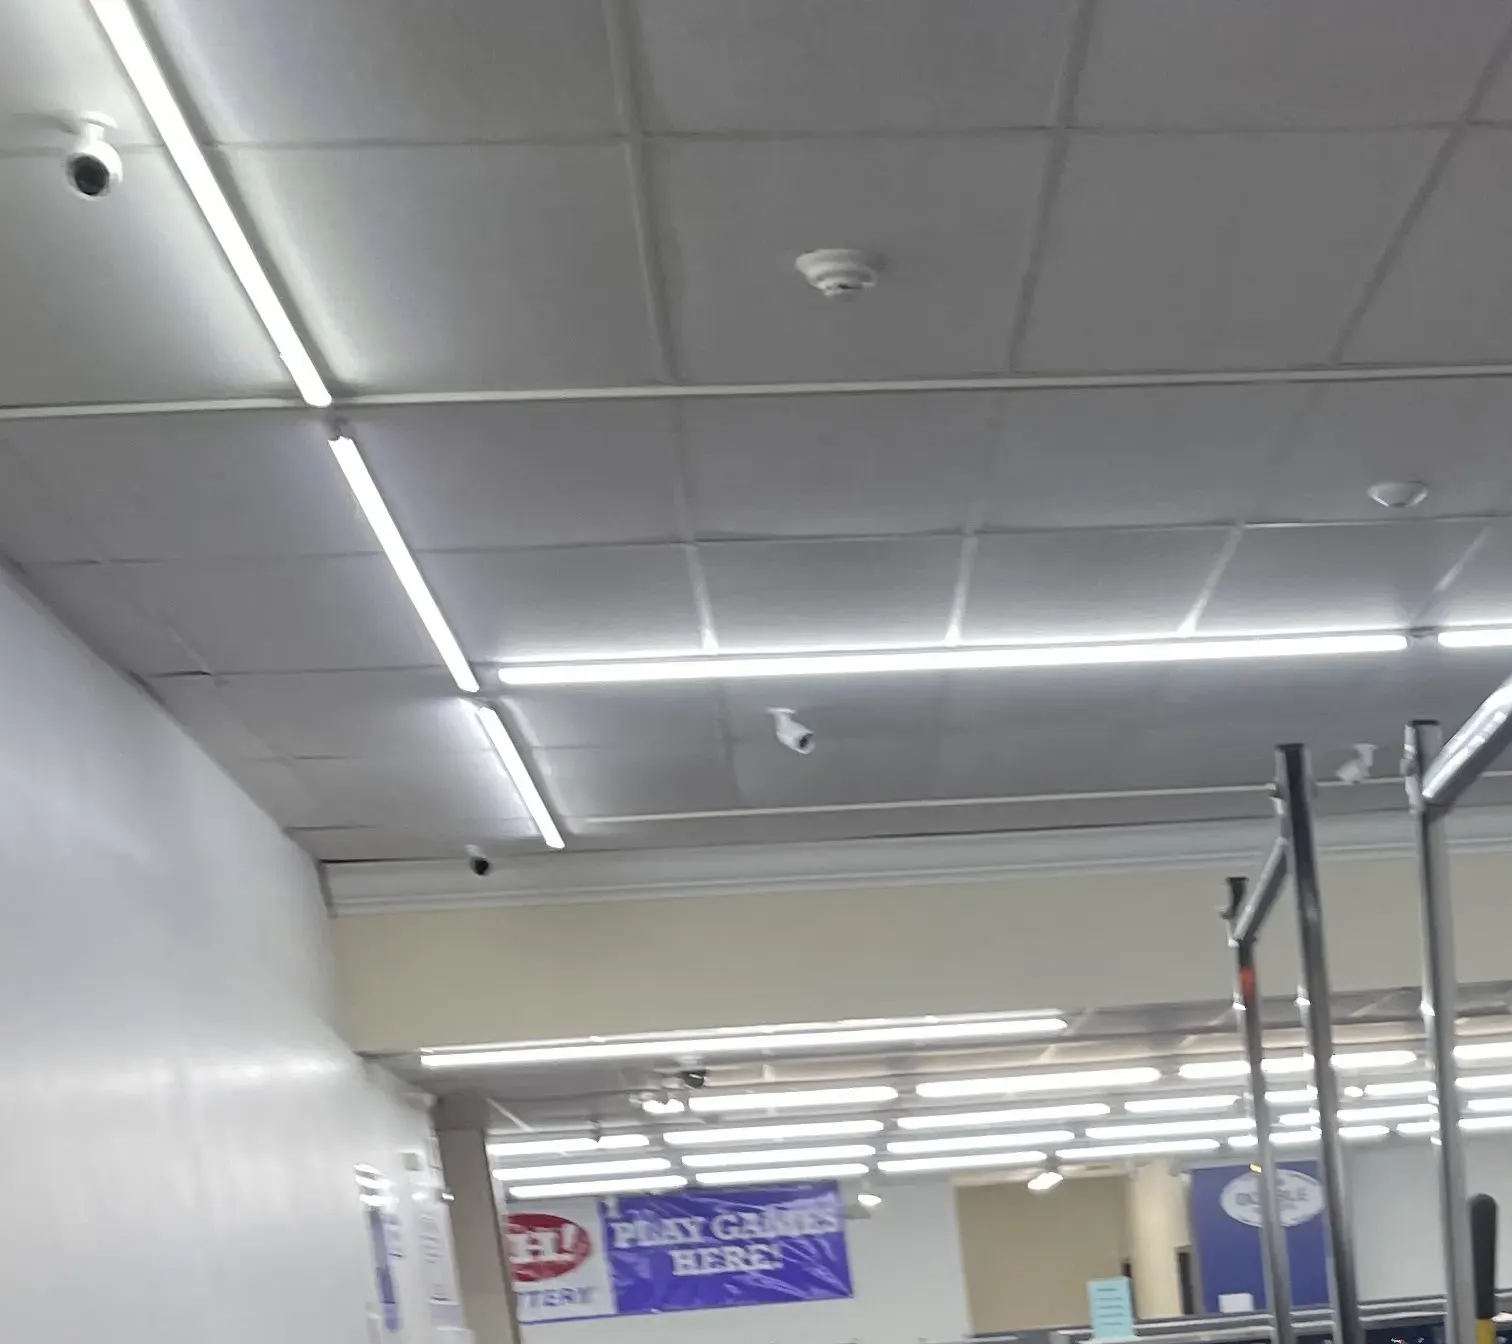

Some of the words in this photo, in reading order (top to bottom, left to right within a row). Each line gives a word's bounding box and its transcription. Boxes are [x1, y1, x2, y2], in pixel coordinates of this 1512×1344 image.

[506, 1222, 577, 1264] H!
[608, 1216, 706, 1249] PLAY
[710, 1207, 838, 1241] GAMES
[668, 1243, 784, 1276] HERE!
